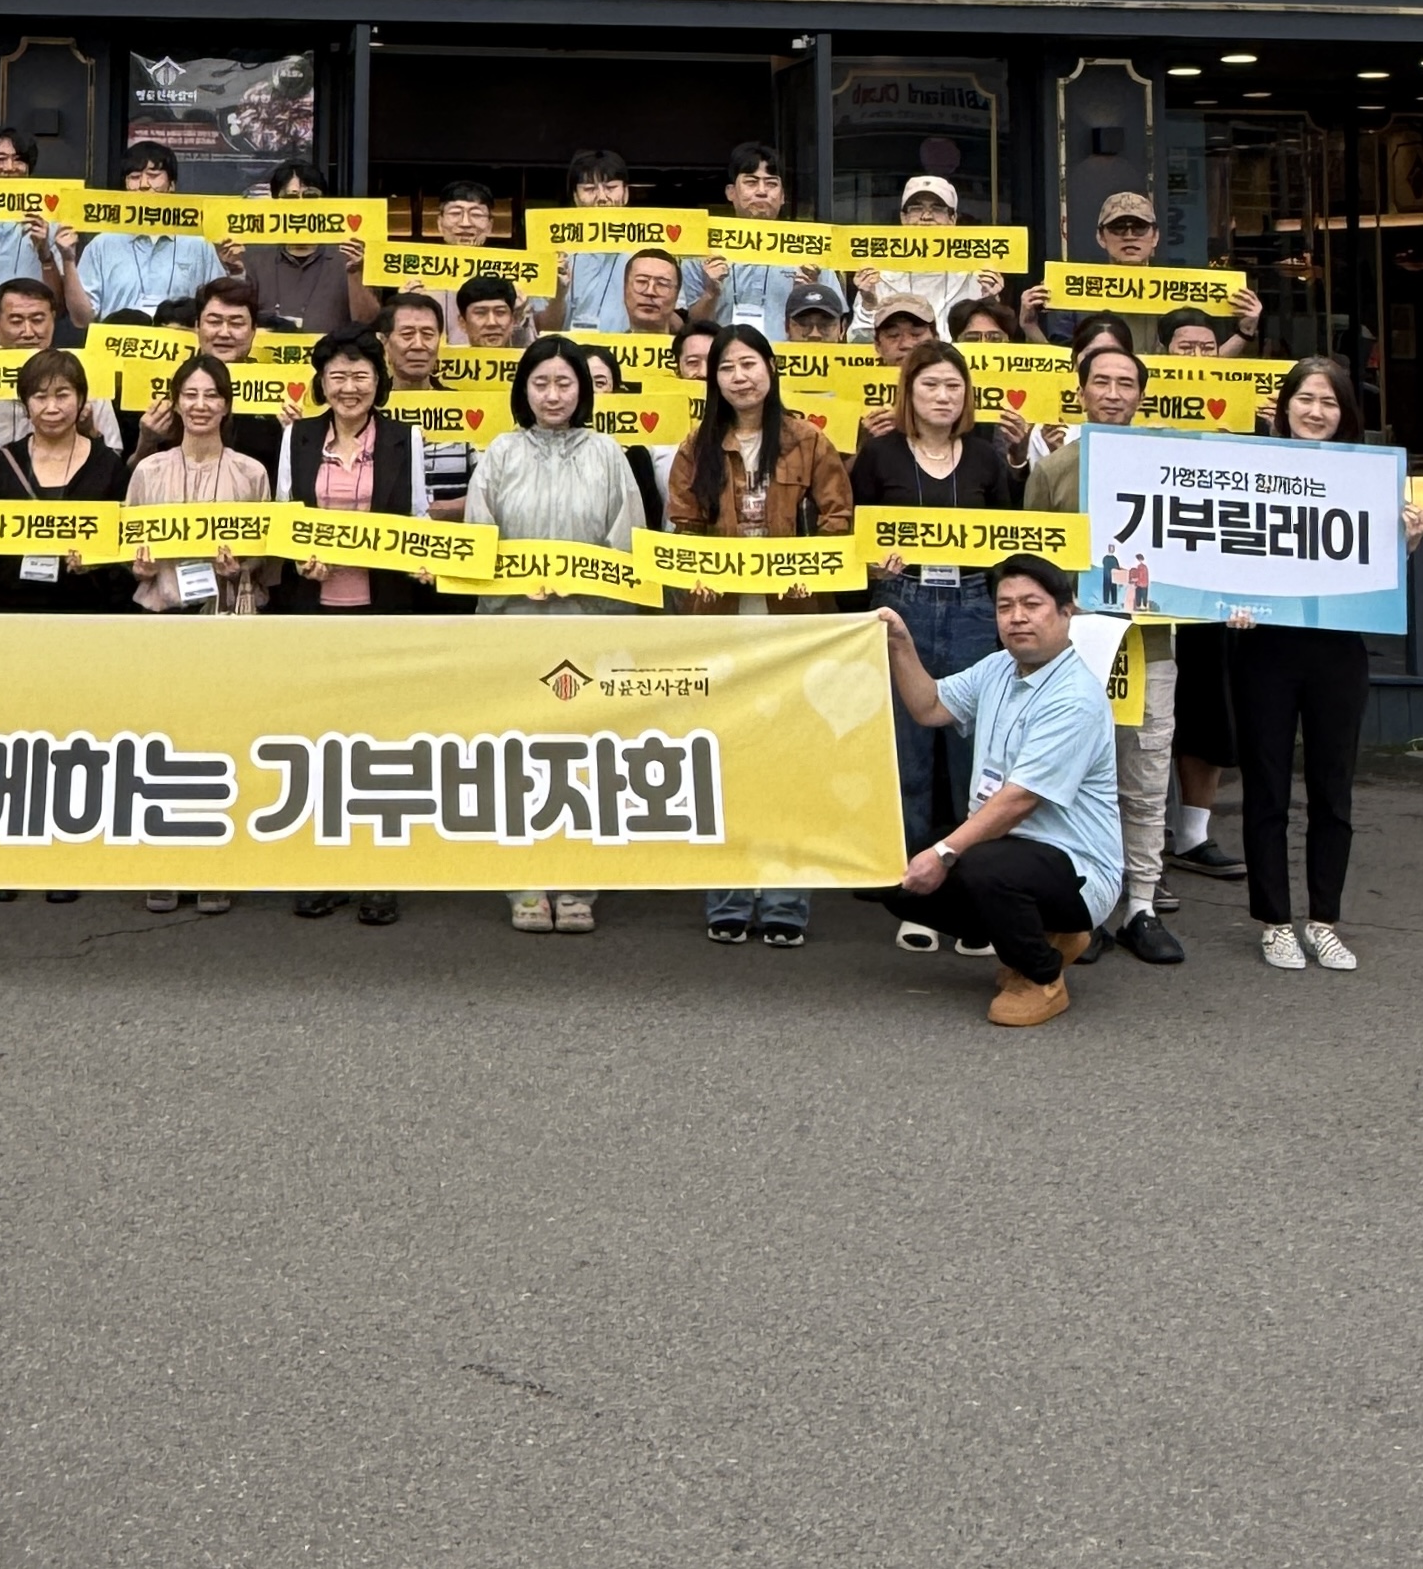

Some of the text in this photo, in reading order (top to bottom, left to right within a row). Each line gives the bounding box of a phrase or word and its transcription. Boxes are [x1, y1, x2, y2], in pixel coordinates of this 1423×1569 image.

[707, 228, 763, 251] 륜진사
[933, 238, 1010, 259] 가맹점주
[1149, 279, 1228, 304] 가맹점주
[776, 355, 829, 378] 륜진사
[1139, 395, 1206, 422] 부해요
[1160, 465, 1249, 492] 가맹점주와
[11, 515, 99, 540] 가맹점주
[119, 517, 190, 544] 륜진사
[292, 520, 475, 562] 명륜진사 가맹점주
[876, 521, 1067, 552] 명륜진사 가맹점주
[1113, 492, 1370, 565] 기부릴레이
[750, 550, 844, 576] 가맹점주
[258, 735, 718, 839] 기부바자회
